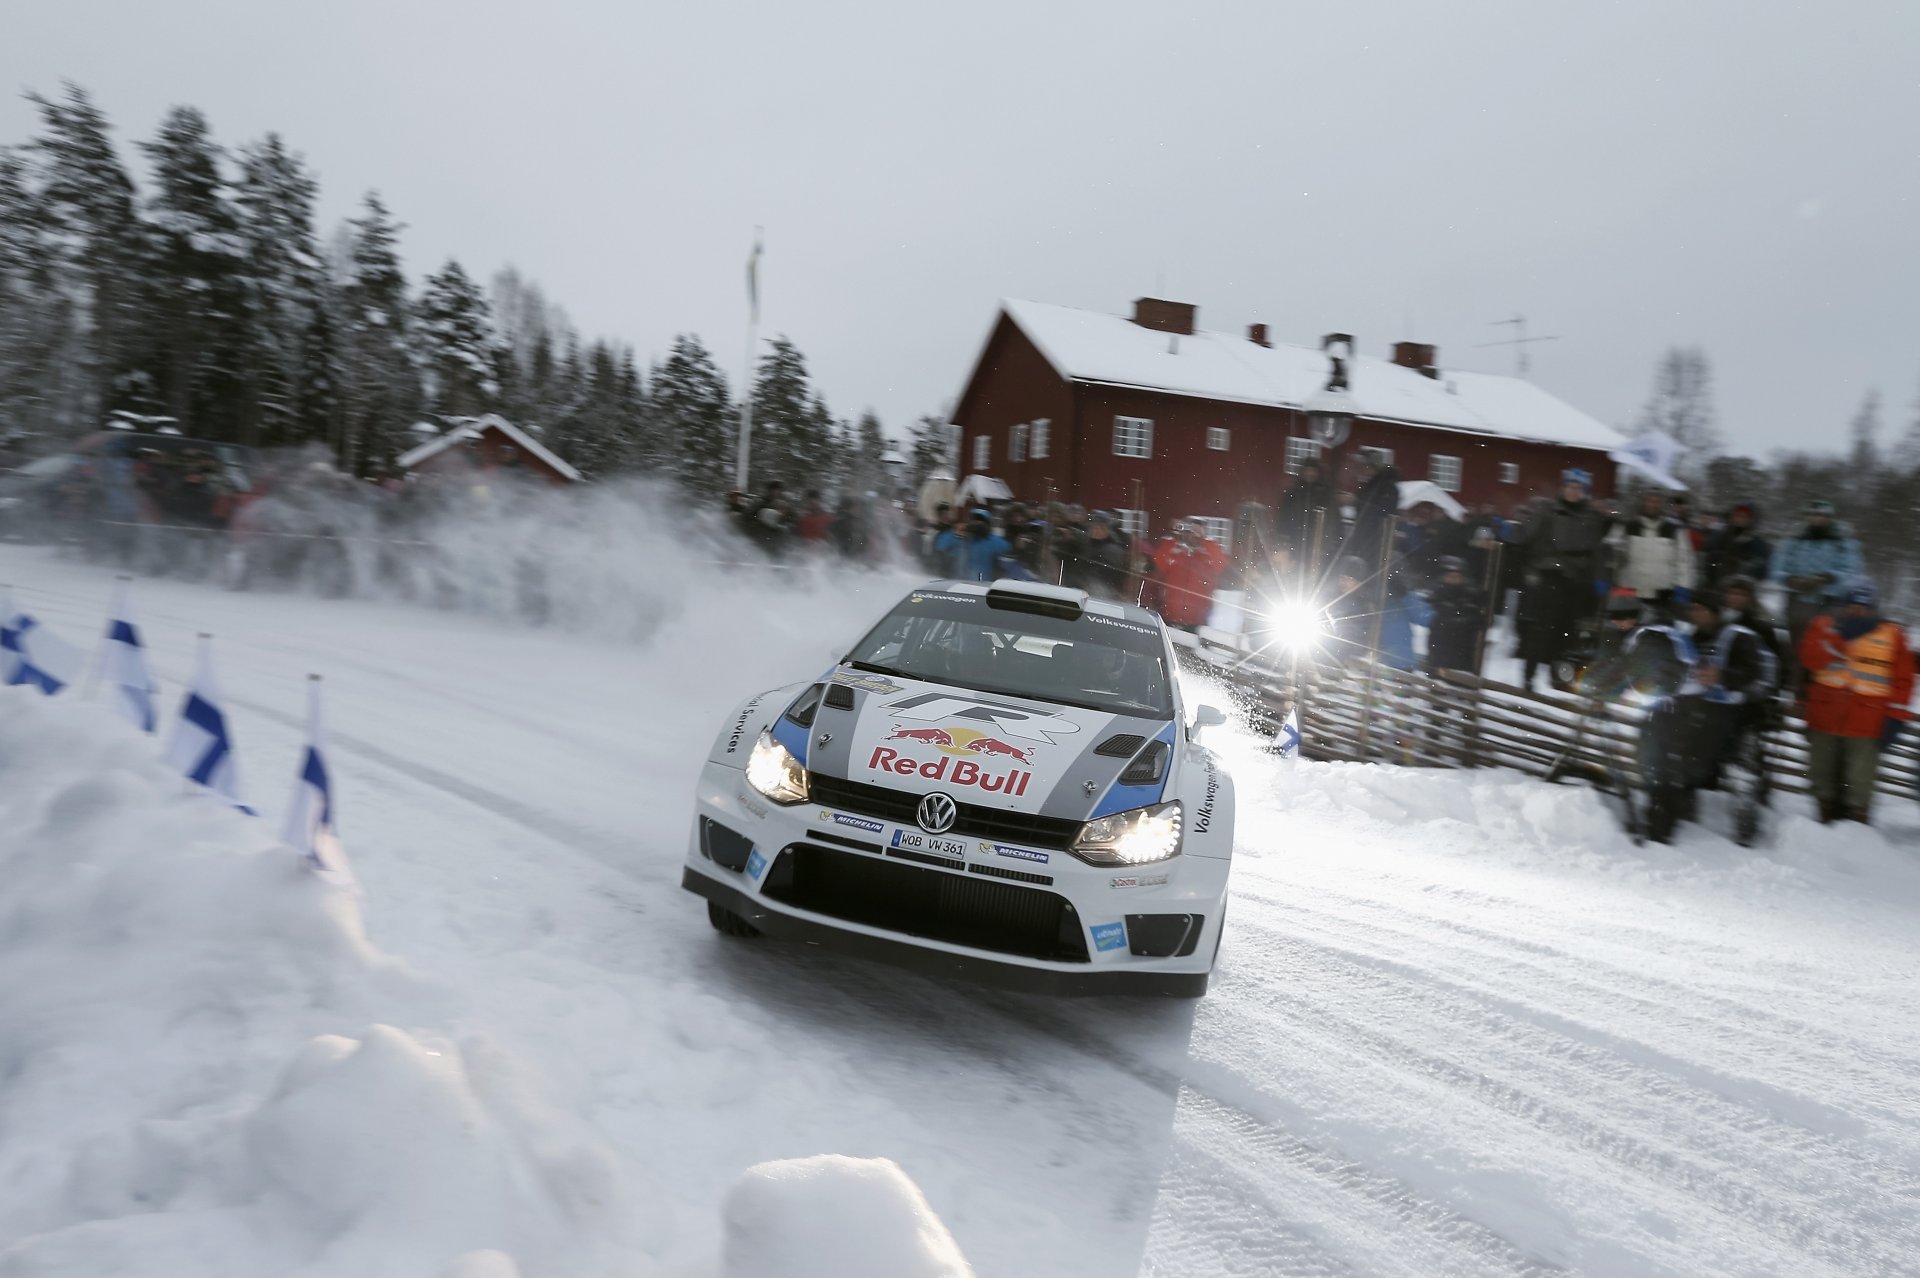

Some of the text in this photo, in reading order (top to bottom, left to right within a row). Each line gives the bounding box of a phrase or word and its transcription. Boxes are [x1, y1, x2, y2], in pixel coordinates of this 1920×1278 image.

[911, 592, 977, 604] Volkswagen
[1086, 615, 1158, 636] Volkswagen
[727, 709, 755, 753] Services
[868, 746, 1032, 797] Red Bull
[1194, 774, 1219, 833] Volkswagen
[837, 816, 883, 831] MICHELIN
[901, 833, 923, 847] WOB
[999, 848, 1049, 862] MICHELIN
